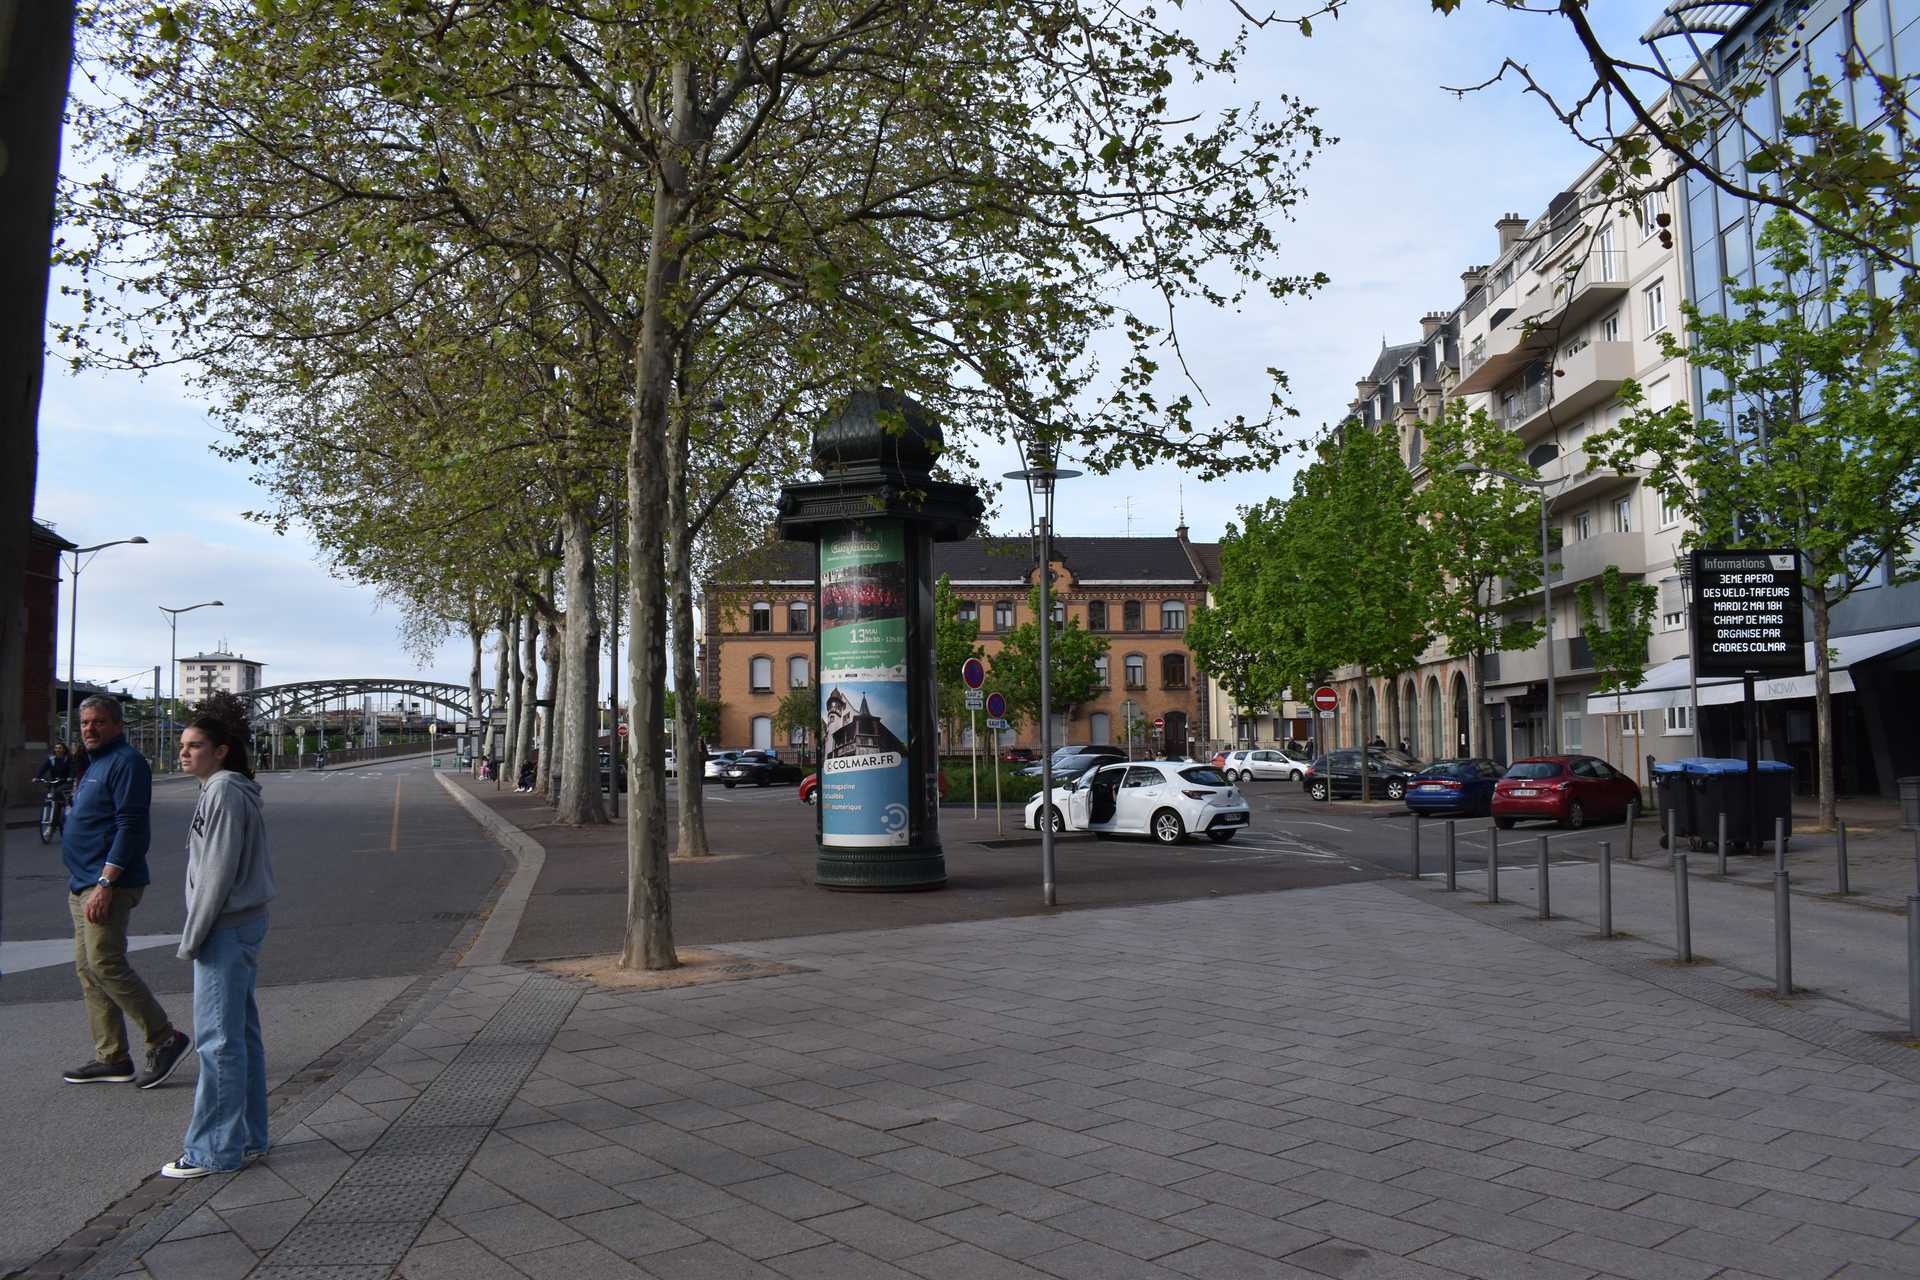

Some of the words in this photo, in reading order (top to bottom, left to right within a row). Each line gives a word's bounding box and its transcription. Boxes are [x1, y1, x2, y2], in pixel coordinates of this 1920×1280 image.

[1704, 559, 1766, 569] Informations
[1720, 574, 1743, 584] 3EME
[1744, 574, 1774, 584] APERO
[1703, 588, 1721, 598] DES
[1722, 587, 1790, 598] VELO-TAFEURS
[1714, 602, 1741, 611] MARDI
[1742, 601, 1748, 611] 2
[1750, 601, 1765, 611] MAI
[1767, 601, 1783, 611] 18H
[1713, 615, 1744, 625] CHAMP
[1745, 615, 1758, 625] DE
[1759, 615, 1784, 625] MARS
[849, 628, 865, 643] 13
[1717, 629, 1761, 639] ORGANISE
[1762, 628, 1781, 638] PAR
[1712, 643, 1748, 652] CADRES
[1750, 642, 1786, 652] COLMAR
